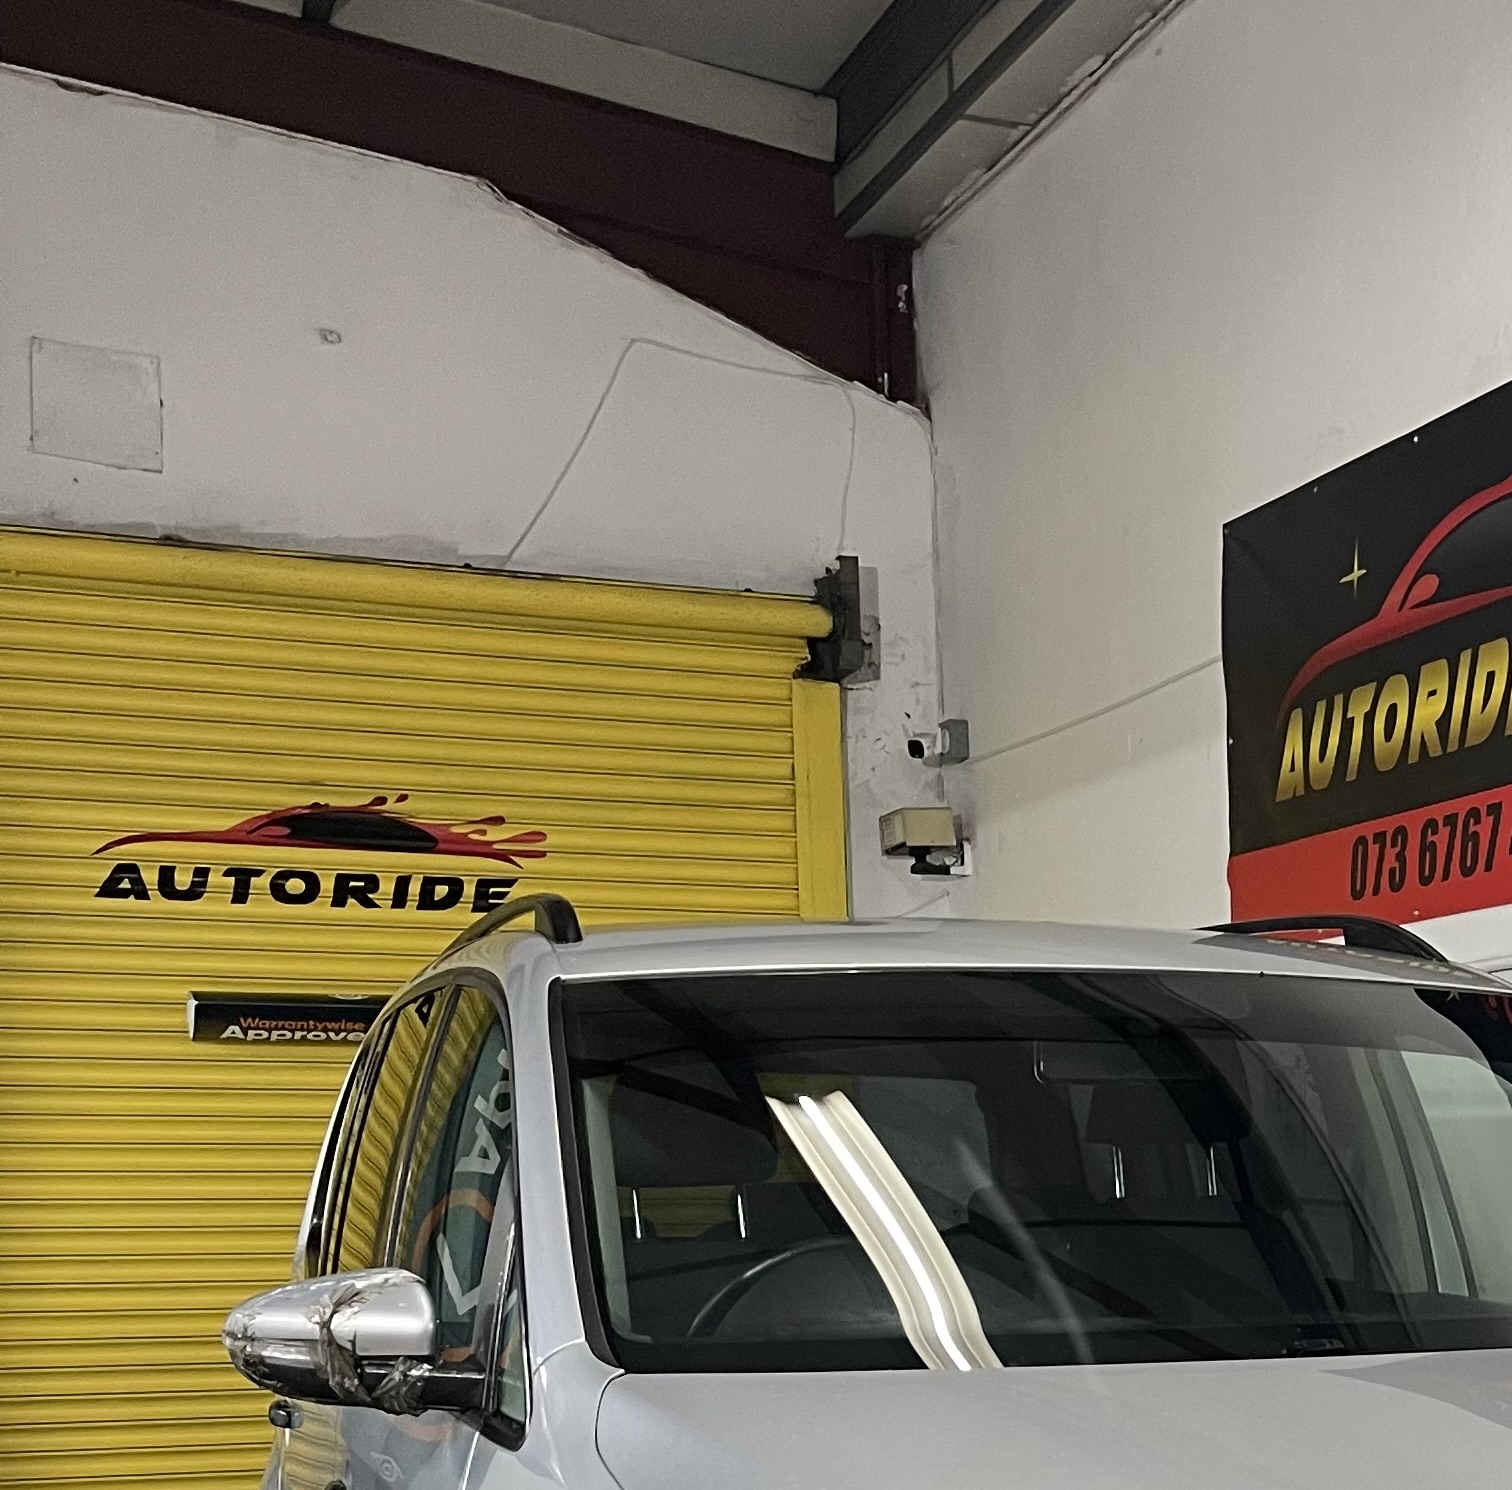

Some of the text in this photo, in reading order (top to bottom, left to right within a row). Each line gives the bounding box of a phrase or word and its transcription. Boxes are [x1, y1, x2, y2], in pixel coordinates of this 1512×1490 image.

[1350, 824, 1409, 901] 073
[1417, 800, 1504, 887] 6767
[94, 862, 520, 914] AUTORIDE
[220, 1024, 367, 1042] Approve
[239, 1016, 367, 1032] Warrantywise
